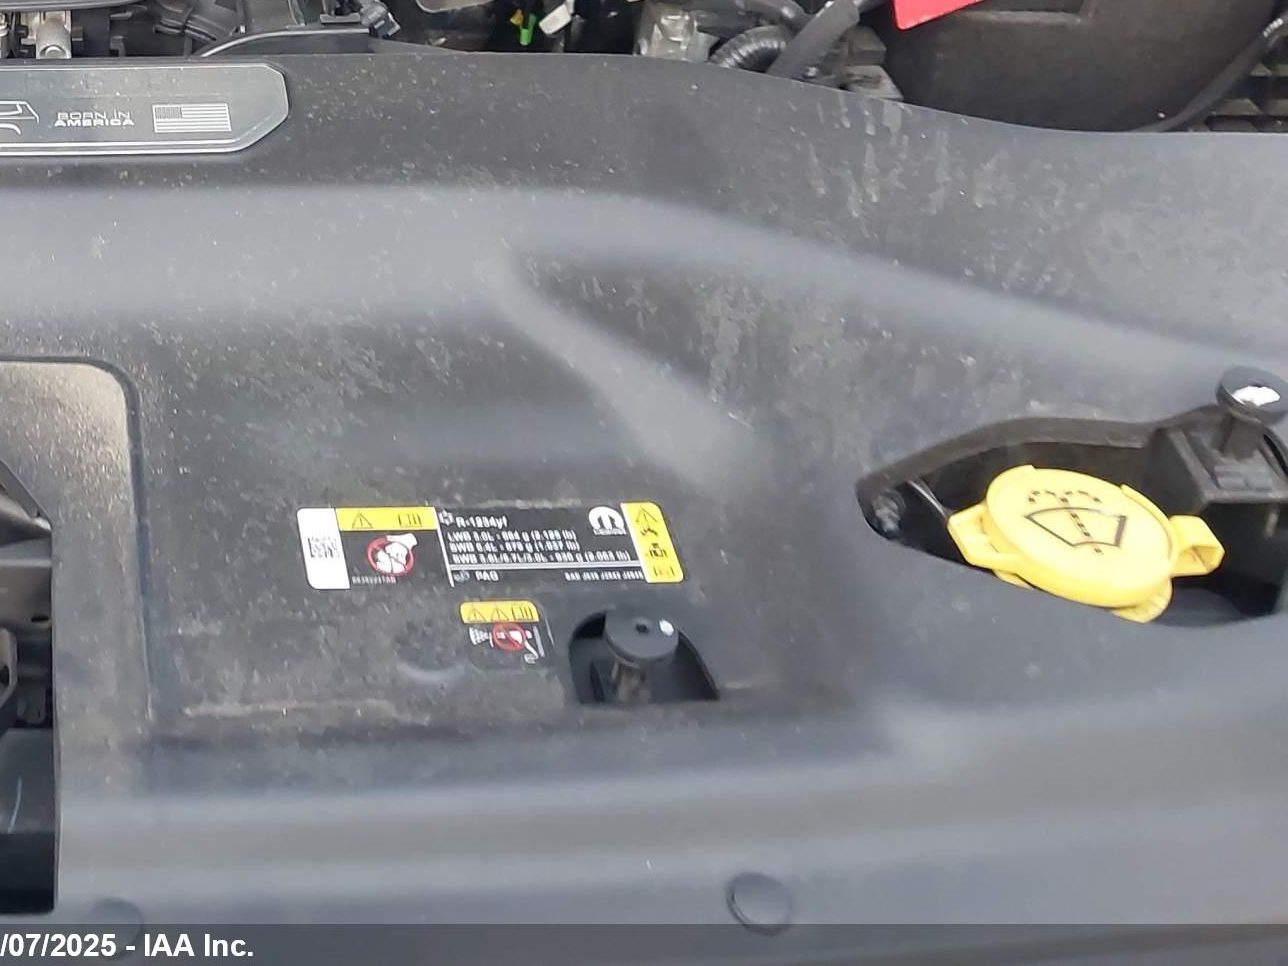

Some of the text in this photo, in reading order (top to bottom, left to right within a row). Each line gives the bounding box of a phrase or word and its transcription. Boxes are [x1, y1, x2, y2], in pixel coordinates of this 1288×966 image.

[57, 110, 130, 120] BORN IN
[54, 119, 135, 127] AMERICA
